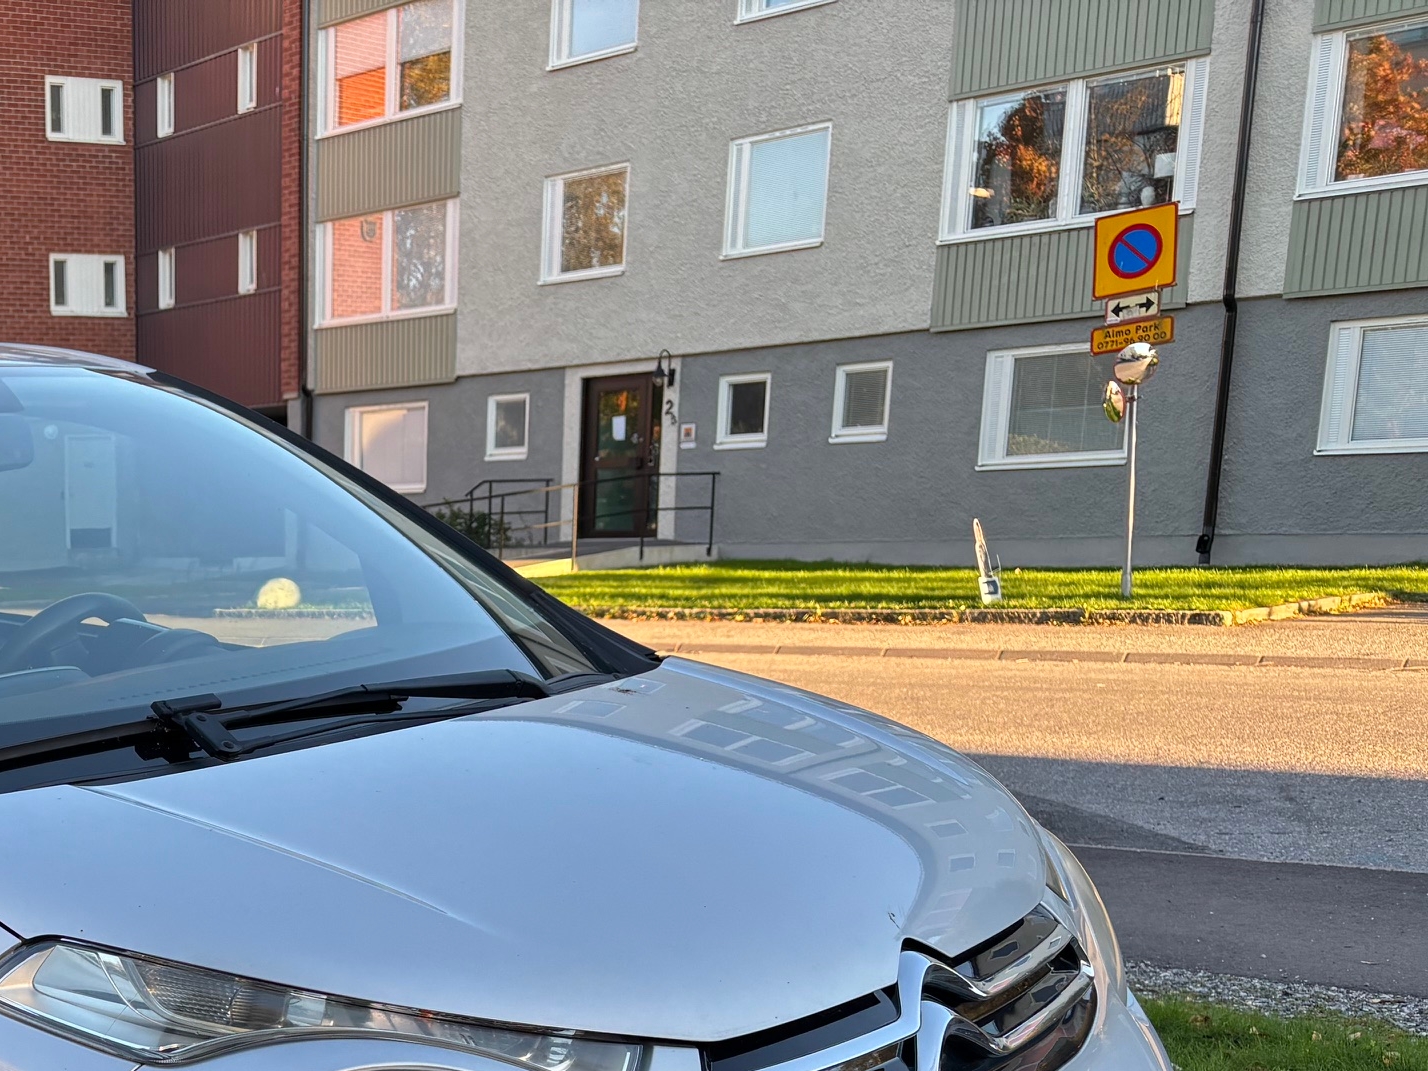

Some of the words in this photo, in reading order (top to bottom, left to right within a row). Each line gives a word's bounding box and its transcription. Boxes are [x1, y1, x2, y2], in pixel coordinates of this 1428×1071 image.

[1135, 322, 1160, 334] Park
[1137, 333, 1151, 342] 90
[1152, 331, 1167, 340] 00
